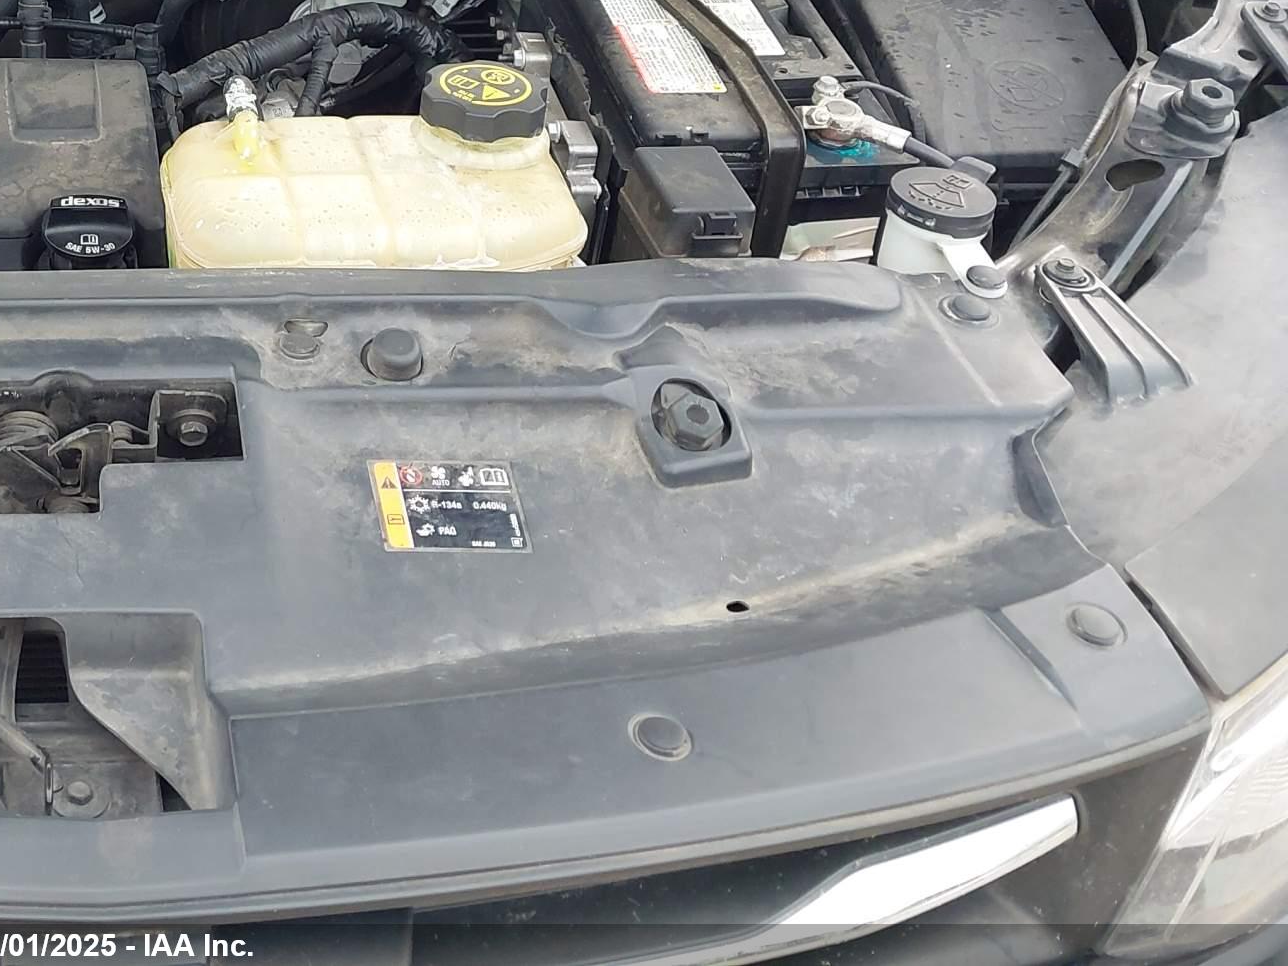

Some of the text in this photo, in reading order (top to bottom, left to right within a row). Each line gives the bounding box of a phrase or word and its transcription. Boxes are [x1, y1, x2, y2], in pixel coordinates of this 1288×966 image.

[60, 196, 120, 208] dexos
[65, 242, 116, 254] SAE 5W-30
